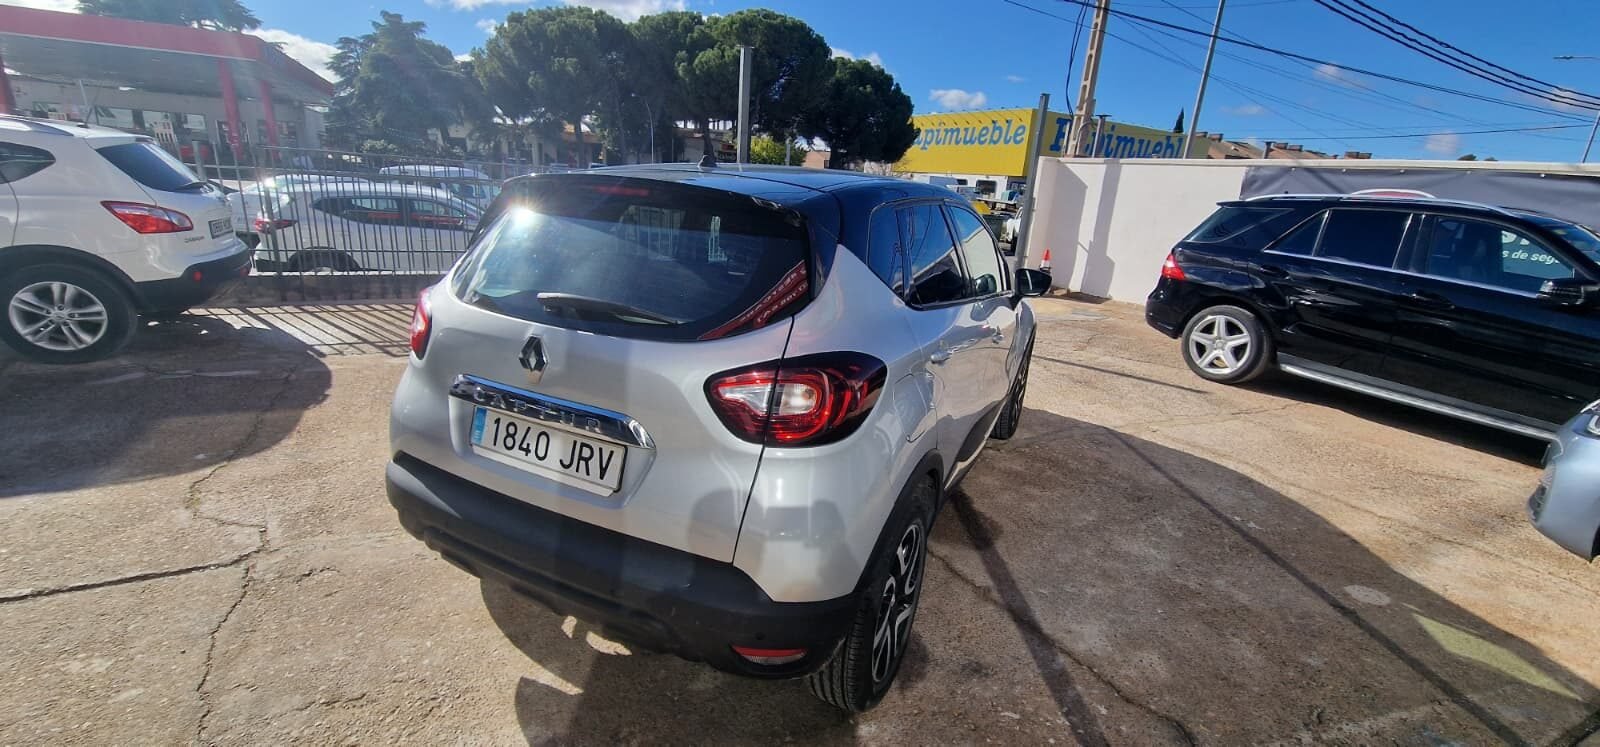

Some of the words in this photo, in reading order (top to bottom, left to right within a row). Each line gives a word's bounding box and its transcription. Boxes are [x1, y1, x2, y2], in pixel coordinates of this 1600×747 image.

[1511, 250, 1529, 260] de
[473, 386, 602, 434] CAPTUR
[493, 417, 550, 461] 1840
[559, 440, 614, 480] JRV
